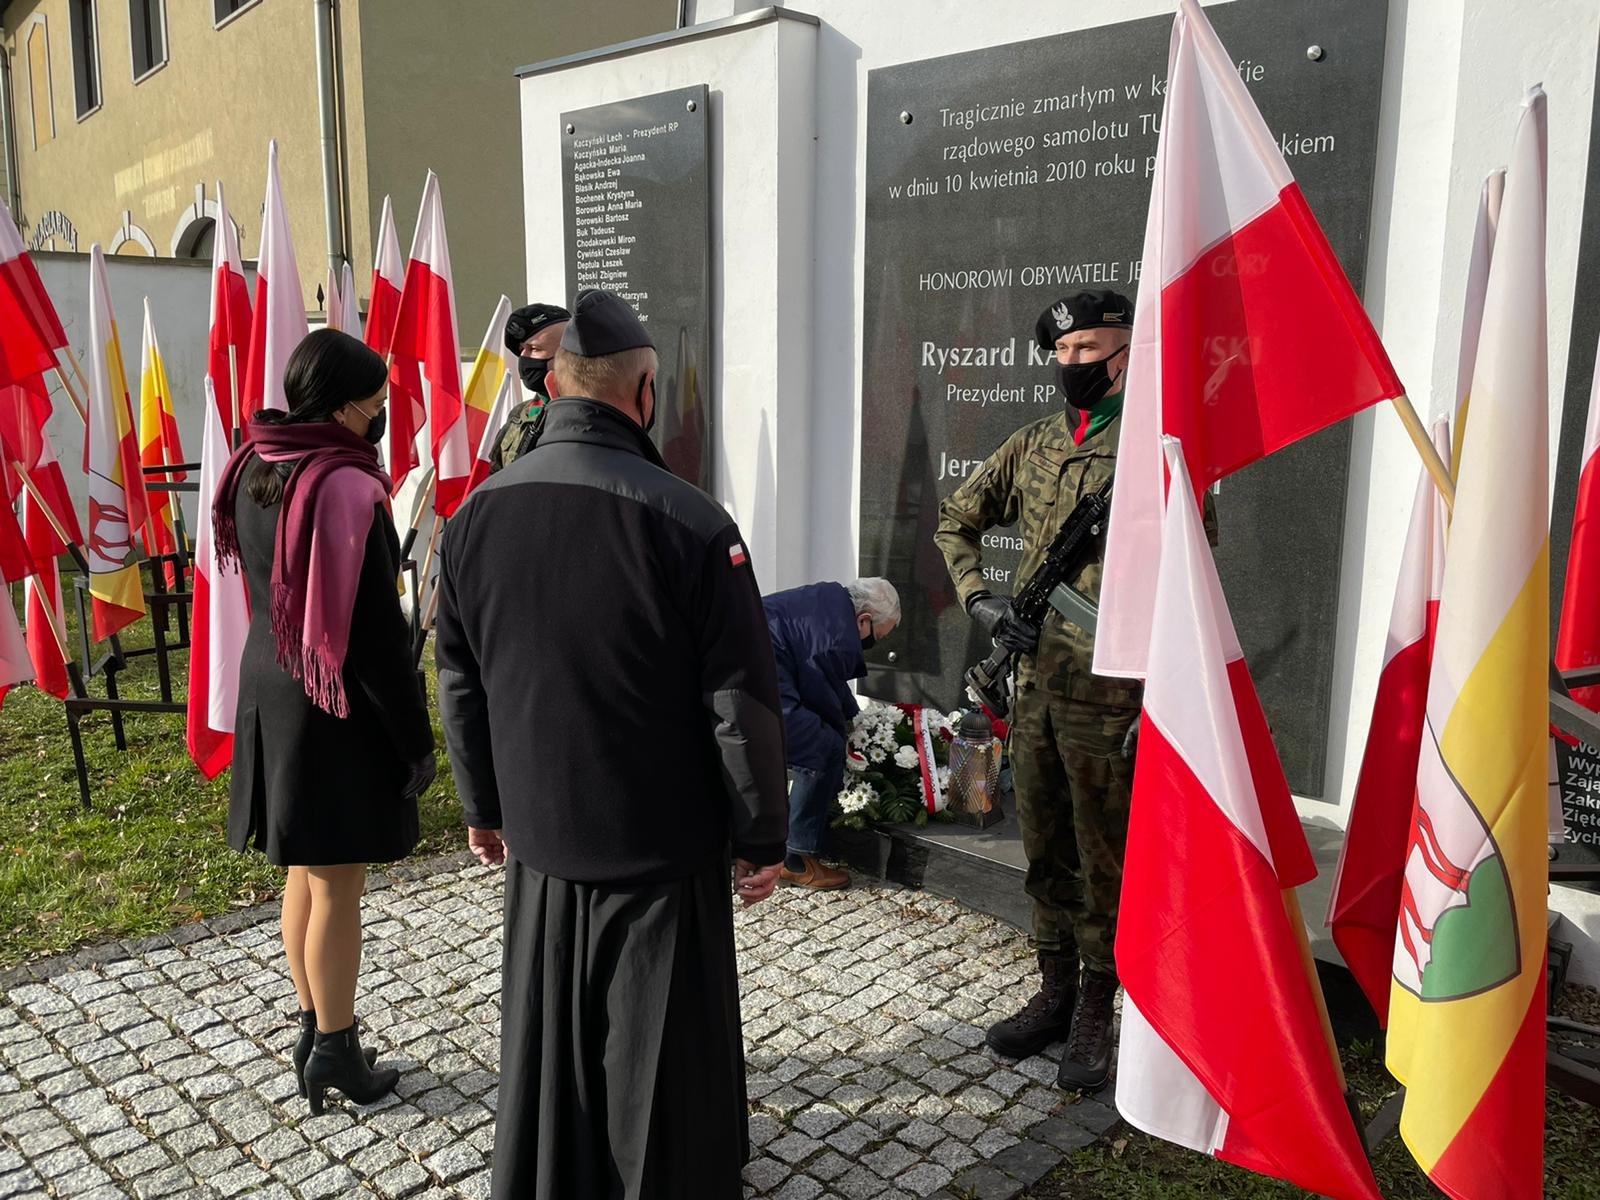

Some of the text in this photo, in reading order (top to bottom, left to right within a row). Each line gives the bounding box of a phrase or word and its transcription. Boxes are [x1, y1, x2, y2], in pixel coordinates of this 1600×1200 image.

[940, 98, 1025, 130] Tragicznie
[1033, 85, 1115, 113] zmarłym
[1125, 83, 1142, 100] w
[573, 136, 606, 149] Kaczyński
[606, 132, 623, 143] Lech
[633, 124, 667, 138] Prezydent
[668, 121, 679, 132] RP
[943, 136, 1035, 163] rządowego
[1043, 119, 1129, 148] samolotu
[573, 144, 627, 160] Kaczyńska Maria
[622, 153, 646, 164] Joanna
[574, 168, 621, 183] Bąkowska Ewa
[889, 185, 903, 199] w
[906, 177, 939, 198] dniu
[945, 174, 963, 193] 10
[970, 165, 1039, 191] kwietnia
[1046, 159, 1087, 182] 2010
[1095, 153, 1136, 177] roku
[594, 179, 618, 190] Andrzej
[575, 190, 635, 204] Bochenek Krystyna
[575, 199, 643, 215] Borowska Anna Maria
[576, 213, 630, 226] Borowski Bartosz
[576, 226, 615, 237] Buk Tadeusz
[576, 234, 636, 248] Chodakowski Miron
[602, 258, 623, 268] Leszek
[600, 270, 628, 281] Zbigniew
[919, 268, 1013, 291] HONOROWI
[1021, 261, 1119, 287] OBYWATELE
[922, 337, 1016, 375] Ryszard
[947, 382, 1056, 408] Prezydent RP
[1565, 772, 1600, 793] Zają
